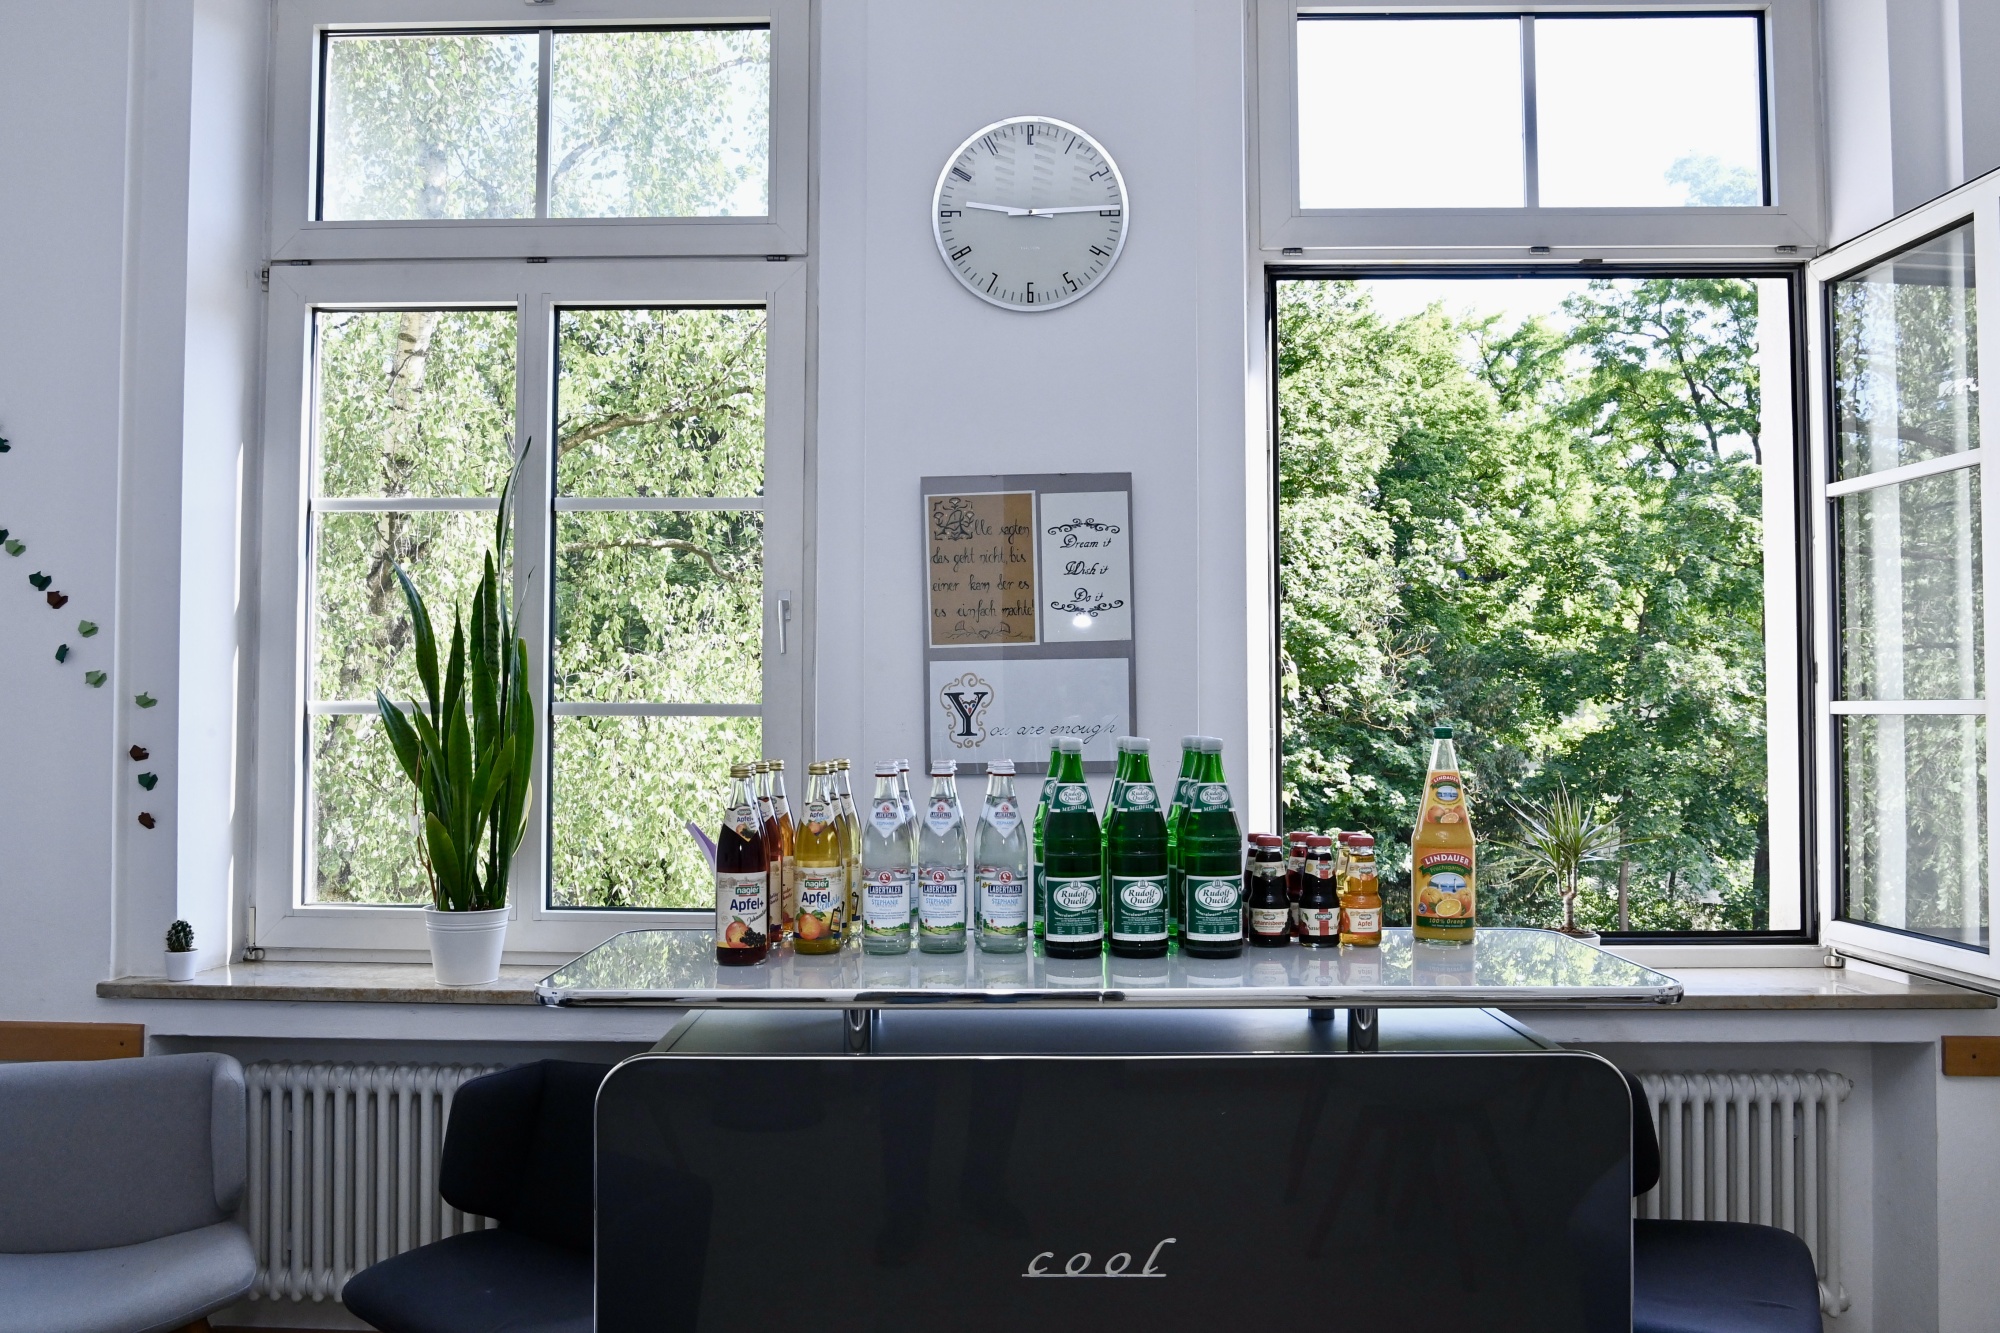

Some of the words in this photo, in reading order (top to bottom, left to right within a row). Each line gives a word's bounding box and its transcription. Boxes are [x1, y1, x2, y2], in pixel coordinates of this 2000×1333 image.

[1026, 124, 1034, 145] 12
[1089, 166, 1110, 182] 2
[952, 246, 972, 261] 8
[1089, 245, 1110, 257] 4
[986, 272, 998, 292] 7
[1062, 272, 1078, 292] 5
[1026, 282, 1034, 303] 6
[999, 518, 1030, 544] sagten
[1060, 534, 1098, 548] Dream
[1103, 538, 1112, 548] it
[931, 546, 950, 564] das
[953, 546, 976, 572] geht
[1010, 546, 1026, 563] bis
[1064, 560, 1100, 576] Wish
[1100, 566, 1110, 574] it
[932, 578, 960, 592] einer
[969, 574, 990, 594] kam
[997, 574, 1014, 590] der
[1018, 580, 1030, 590] es
[1070, 588, 1092, 602] Do
[1095, 592, 1104, 602] it
[934, 608, 946, 618] es
[957, 600, 996, 623] einfach
[944, 691, 1011, 737] You
[1016, 725, 1045, 736] are
[1050, 714, 1119, 744] enough
[1425, 854, 1470, 866] LINDAUER
[870, 886, 902, 894] LABERTALER
[924, 885, 956, 894] LABERTALER
[990, 886, 1022, 894] LABERTALER
[1128, 889, 1158, 898] Rudolf-
[1203, 889, 1232, 898] Rudolf-
[802, 892, 830, 904] Apfel
[1064, 897, 1088, 906] Quelle
[1130, 896, 1155, 905] Quelle
[1205, 896, 1230, 905] Quelle
[1026, 1237, 1177, 1277] cool
